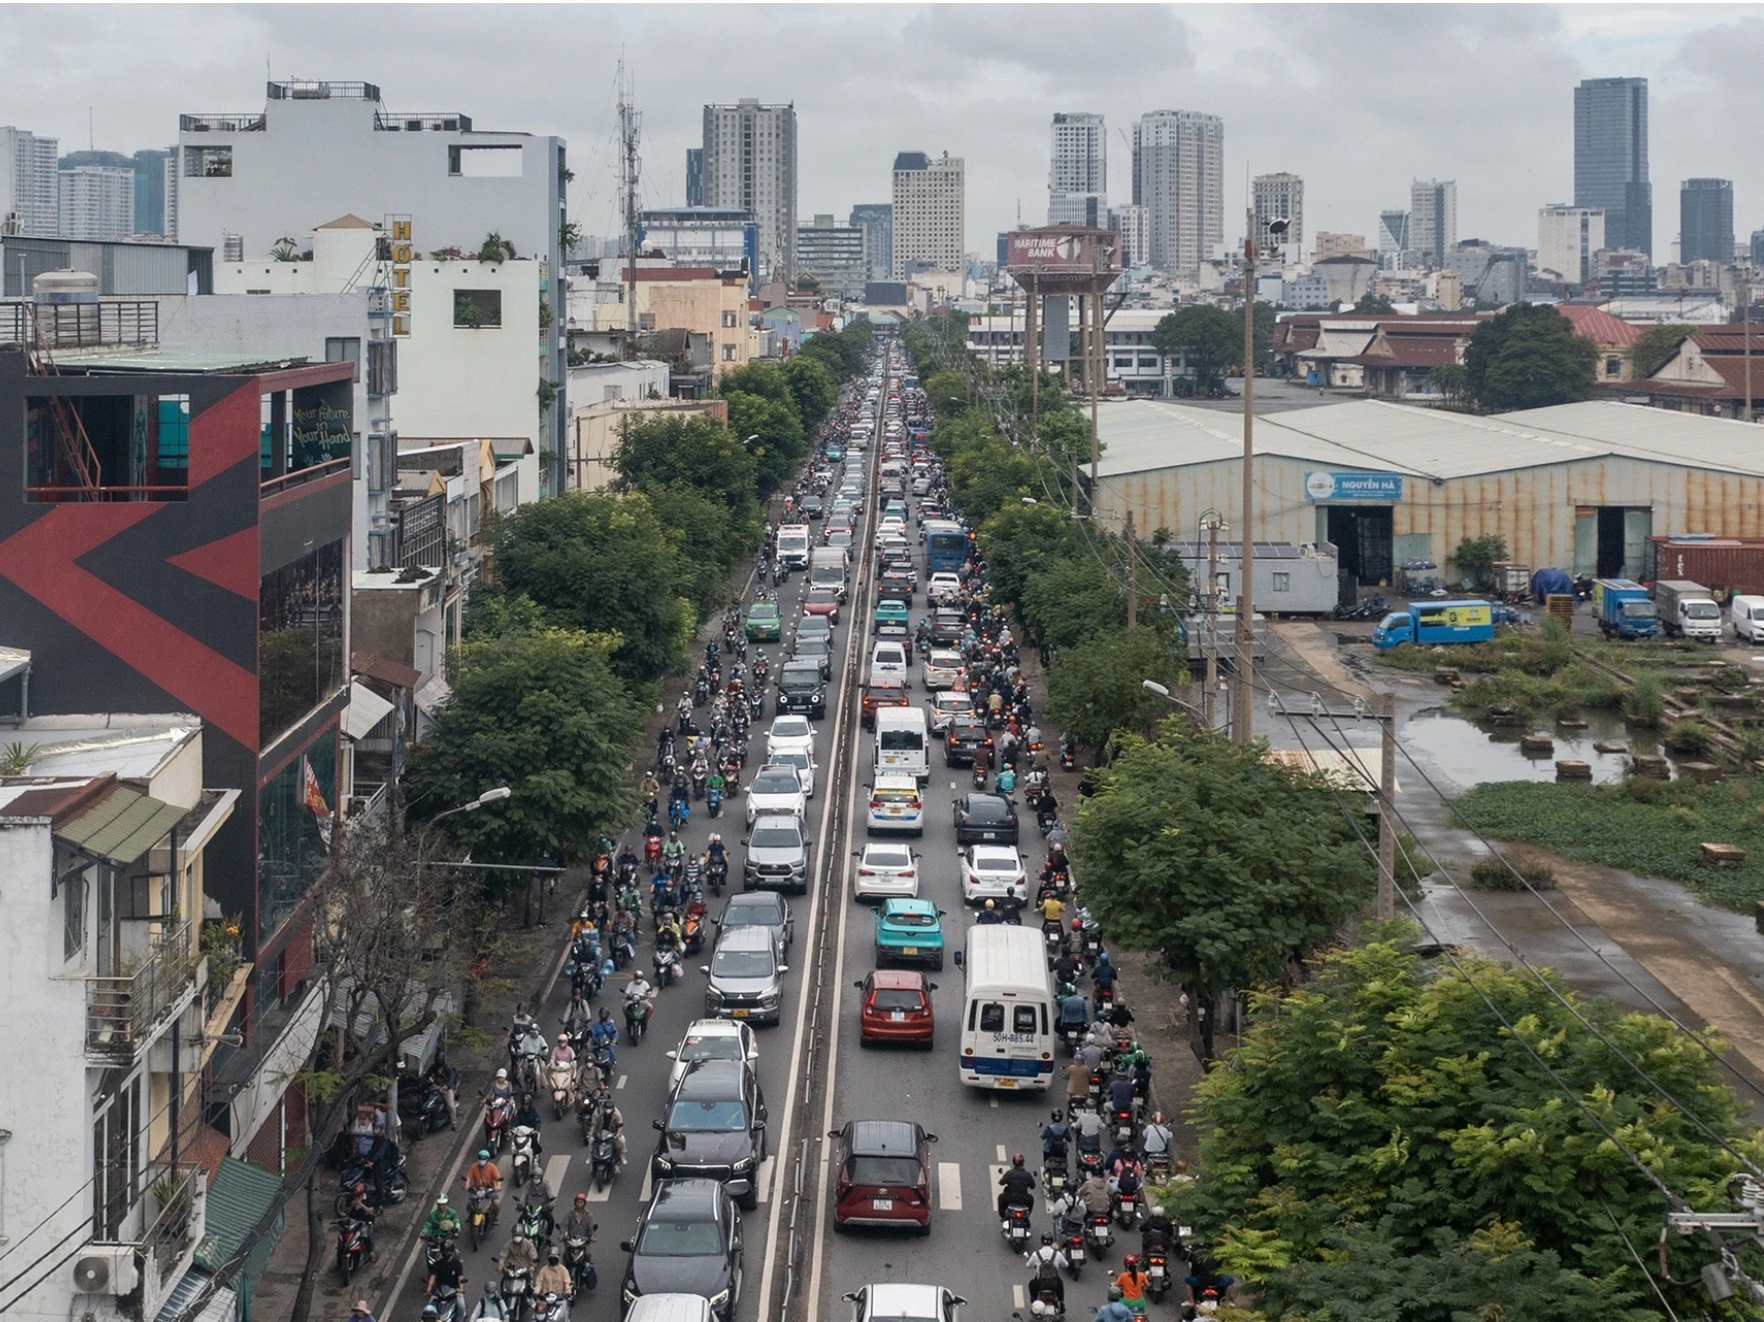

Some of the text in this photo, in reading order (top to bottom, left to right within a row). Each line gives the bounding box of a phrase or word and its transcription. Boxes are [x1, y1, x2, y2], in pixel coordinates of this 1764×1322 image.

[1014, 239, 1057, 248] MARITIME
[1027, 248, 1055, 258] BANK
[392, 221, 411, 335] HOTEL
[293, 405, 351, 425] Your Future
[293, 424, 351, 450] Your Hand
